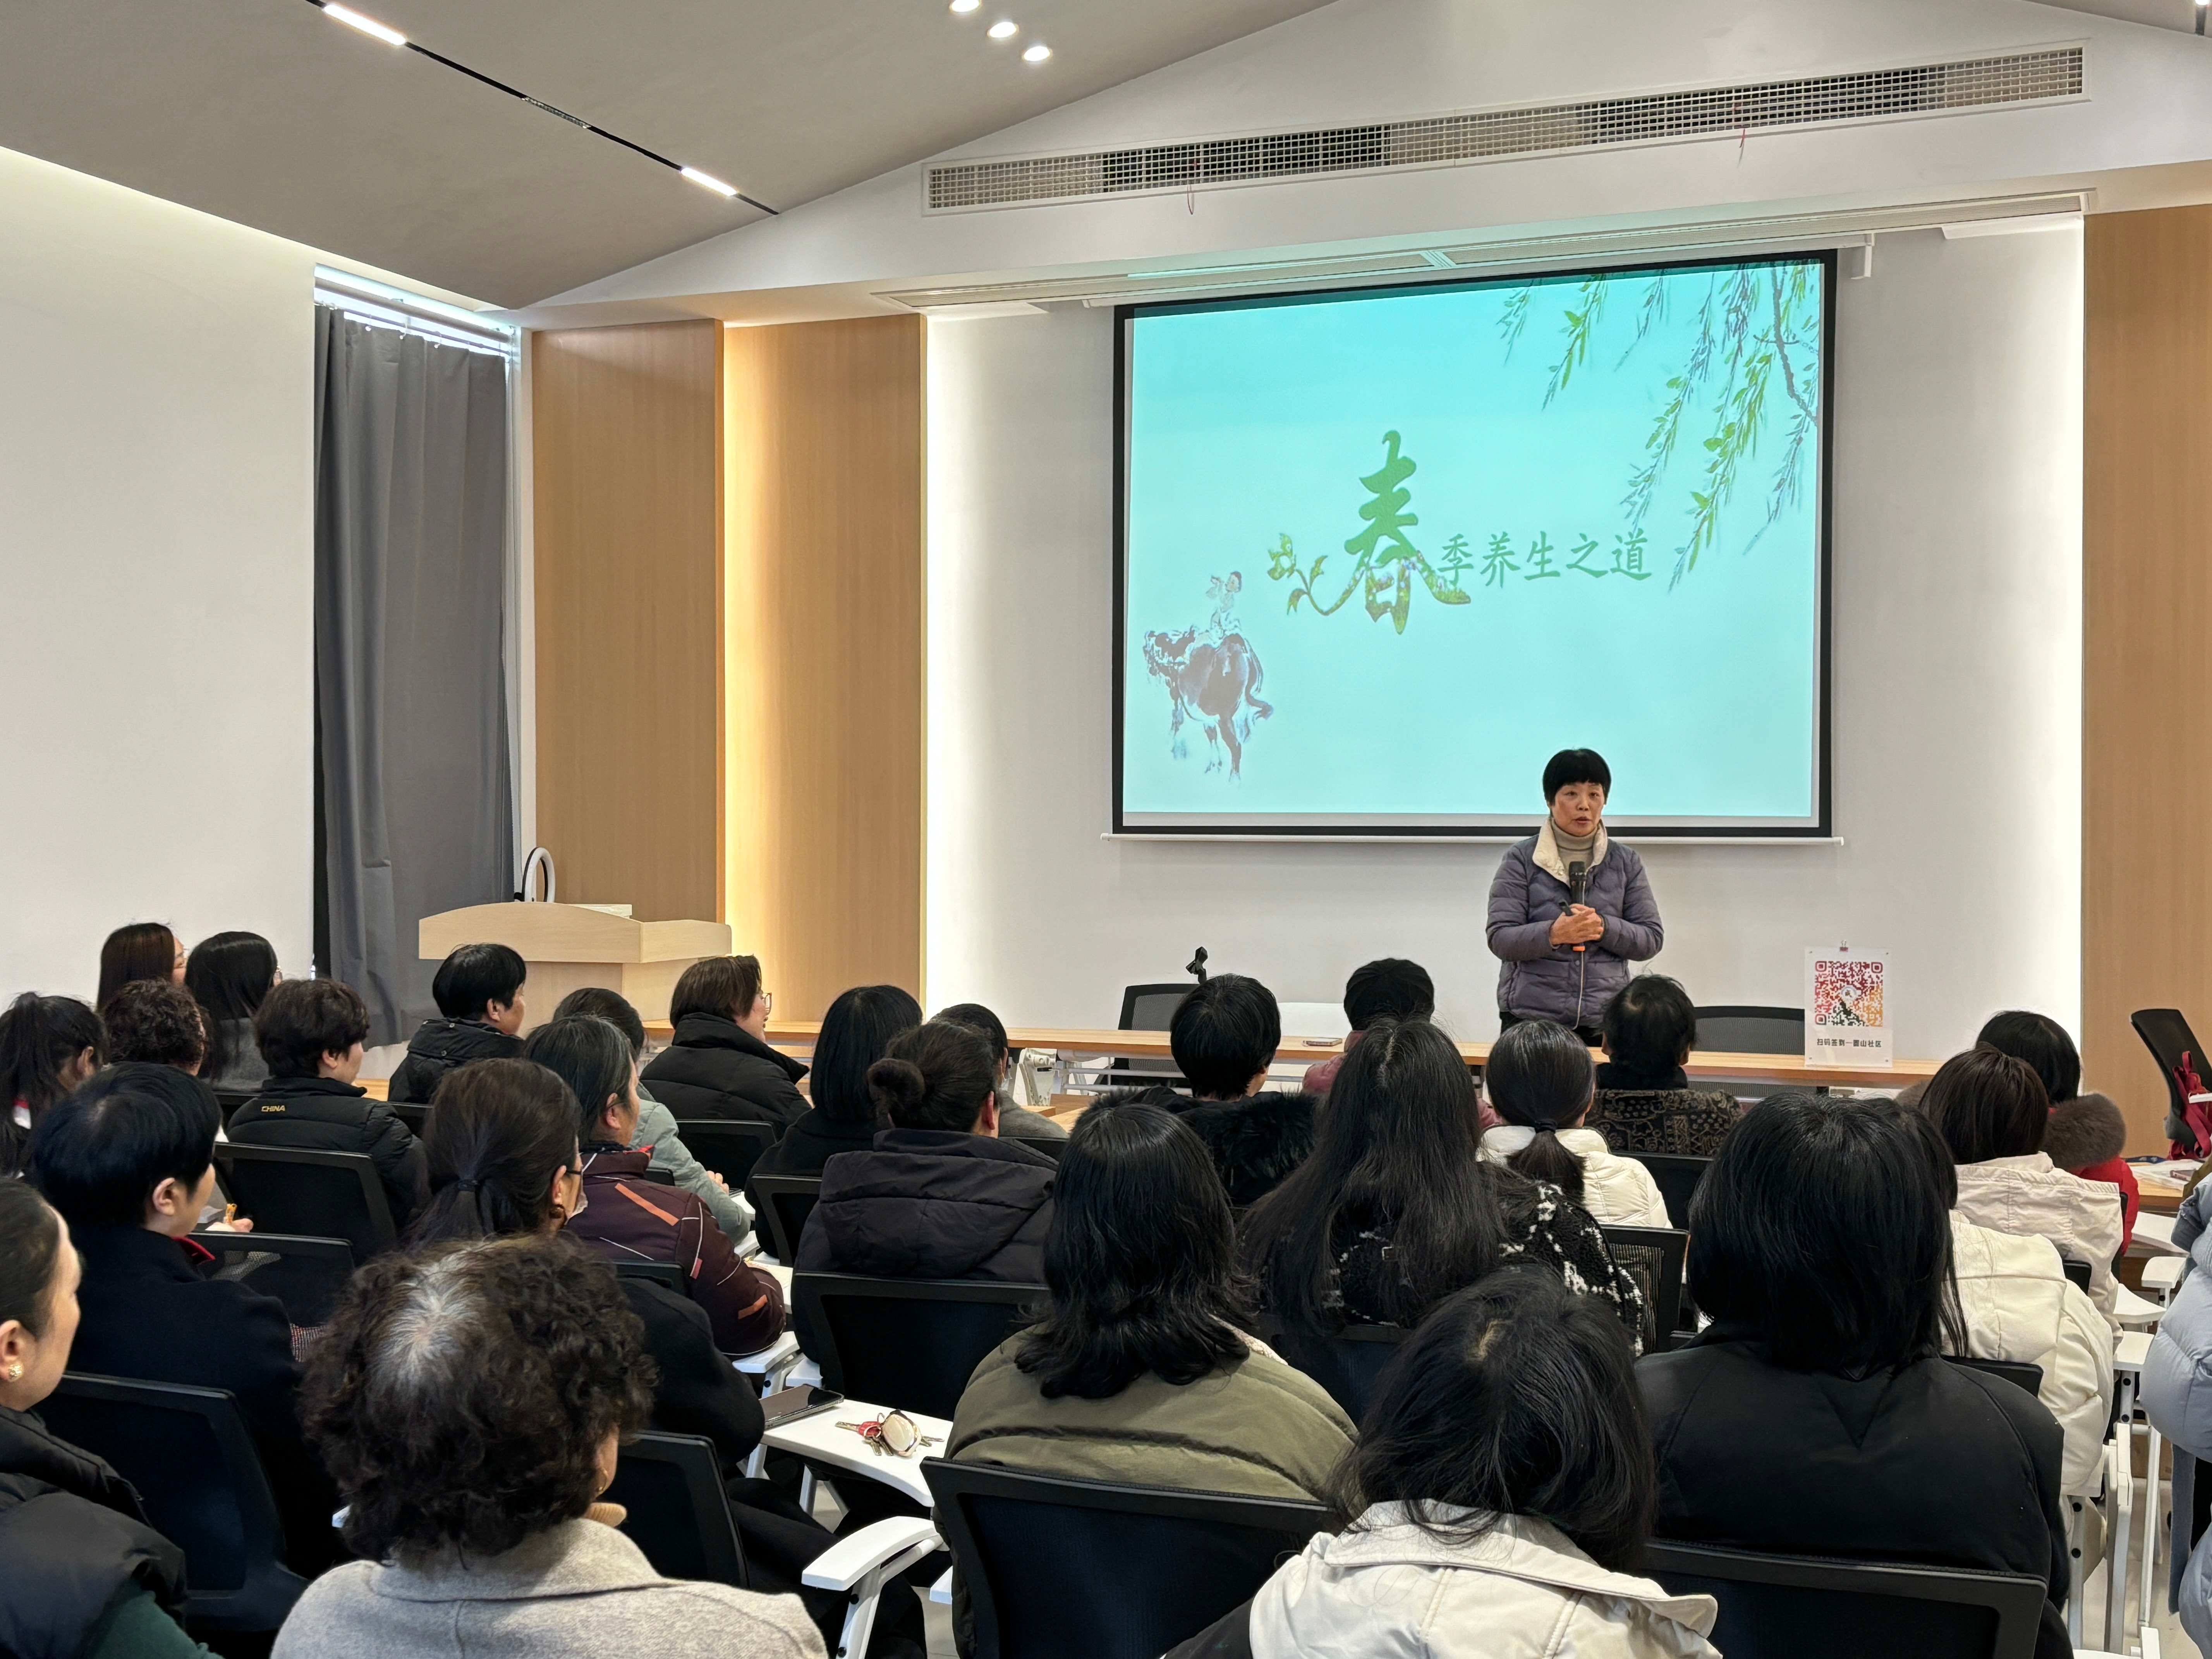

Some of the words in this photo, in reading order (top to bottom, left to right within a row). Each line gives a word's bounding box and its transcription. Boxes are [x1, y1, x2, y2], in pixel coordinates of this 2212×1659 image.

[1334, 430, 1652, 635] 春季养生之道
